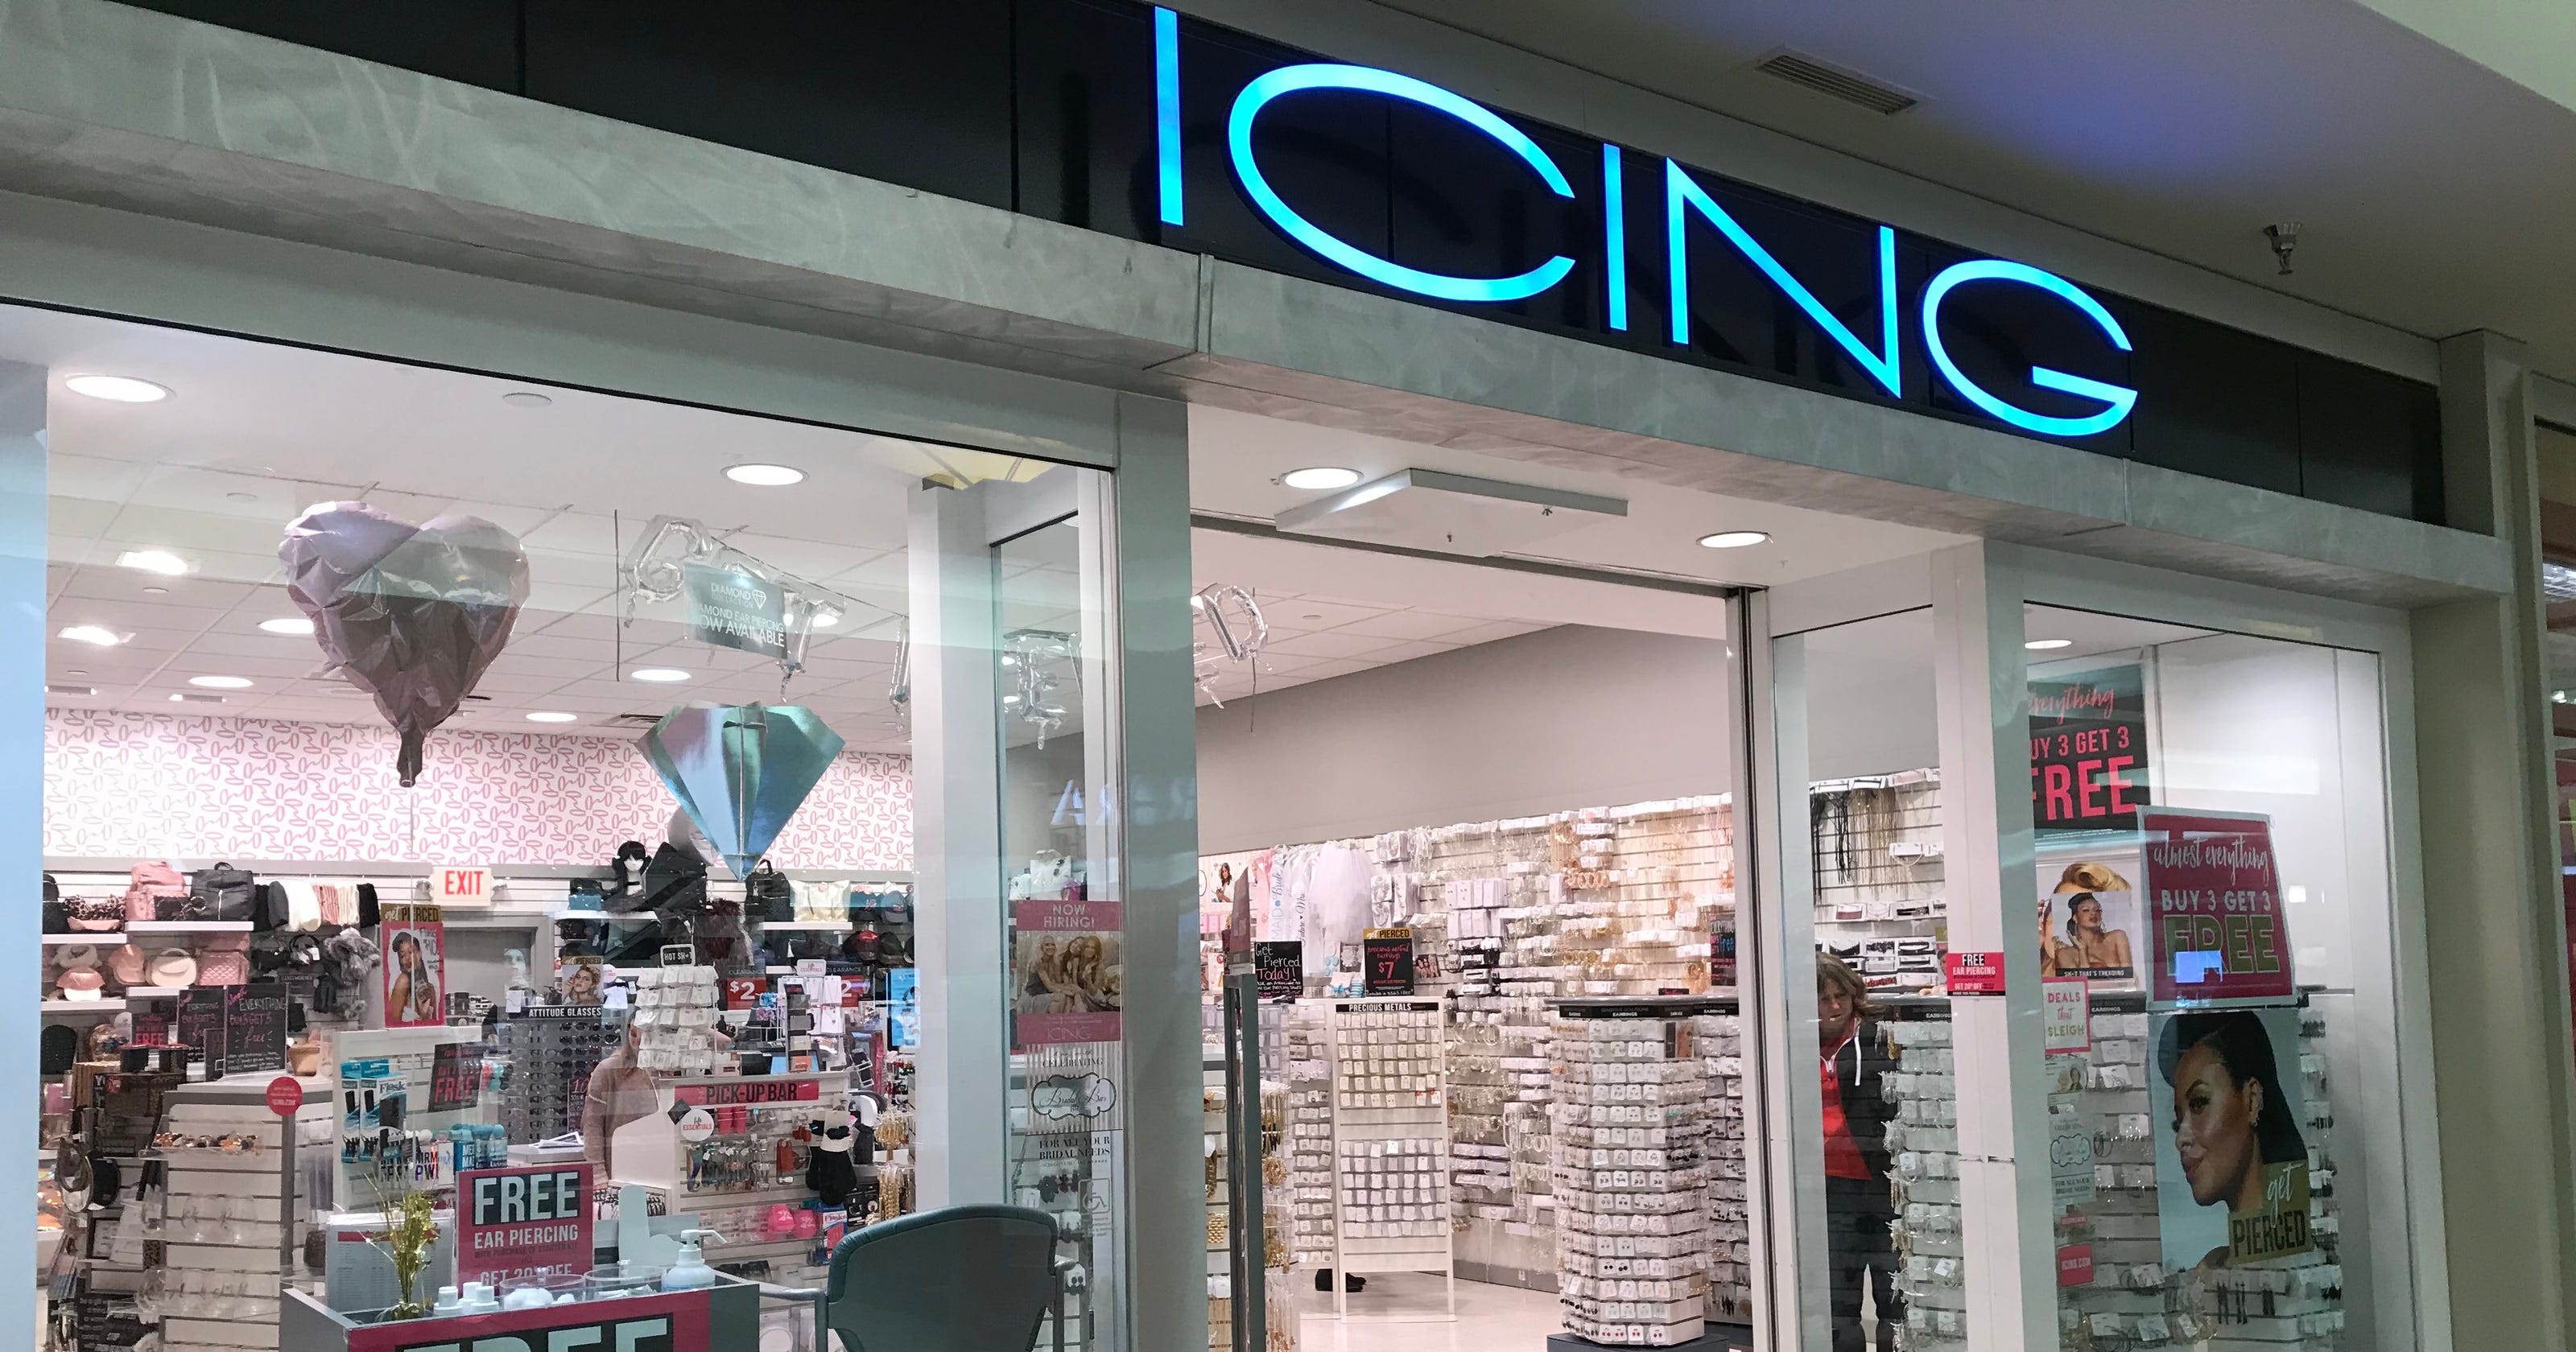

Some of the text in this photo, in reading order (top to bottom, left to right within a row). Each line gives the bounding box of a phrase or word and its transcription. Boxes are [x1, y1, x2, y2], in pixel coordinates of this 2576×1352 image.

[1154, 6, 2137, 437] ICING
[711, 583, 751, 600] DIAMOND
[699, 604, 733, 620] AMOND
[734, 611, 750, 624] EAR
[699, 614, 785, 648] OW AVAILABLE
[2029, 726, 2130, 760] UY 3 GET 3
[2153, 834, 2270, 886] almost everything
[445, 871, 484, 895] EXIT
[2161, 889, 2272, 911] BUY 3 GET 3
[1053, 904, 1086, 915] NOW
[1043, 917, 1095, 928] HIRING!
[1379, 929, 1410, 938] PIERCED
[1256, 942, 1274, 956] Get
[2164, 914, 2281, 976] FREE
[663, 953, 676, 961] HOT
[1264, 954, 1301, 967] Pierced
[1962, 954, 1985, 967] FREE
[1256, 967, 1297, 981] Today!
[1378, 961, 1395, 979] $7
[1952, 966, 1996, 975] EAR PIERCING
[729, 980, 756, 1000] $2
[2048, 991, 2081, 1004] DEALS
[529, 1007, 601, 1017] ATTITUDE GLASSES
[1348, 1004, 1382, 1012] PRECIOUS
[1385, 1003, 1412, 1012] METALS
[2048, 1024, 2084, 1037] SLEIGH
[1042, 1057, 1104, 1069] CELEBRATING
[435, 1075, 475, 1103] FREE
[706, 1082, 798, 1104] PICK-UP BAR
[1039, 1139, 1059, 1149] FOR
[1039, 1148, 1110, 1160] BRIDAL NEEDS
[474, 1171, 578, 1225] FREE
[2267, 1162, 2307, 1229] get
[474, 1224, 579, 1250] EAR PIERCING
[2232, 1210, 2306, 1258] PIERCED
[481, 1268, 509, 1288] GET
